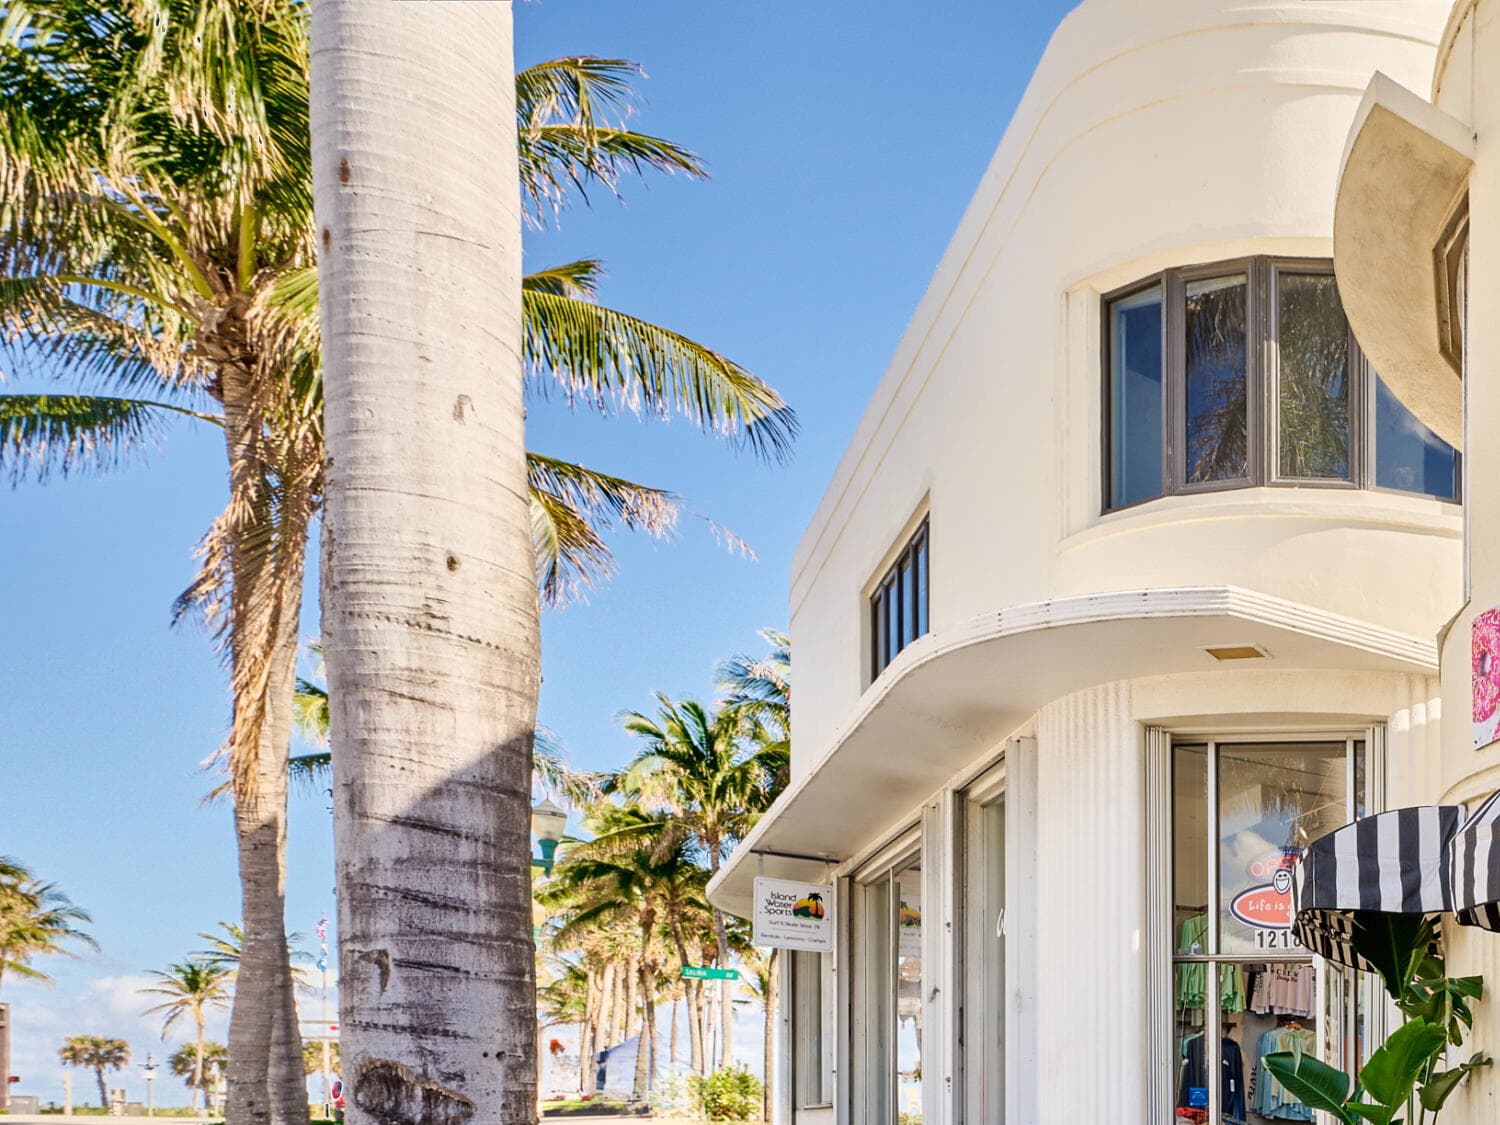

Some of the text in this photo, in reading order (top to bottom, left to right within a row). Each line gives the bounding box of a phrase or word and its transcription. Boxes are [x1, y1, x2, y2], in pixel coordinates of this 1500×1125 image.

[771, 891, 796, 901] Island
[765, 898, 792, 909] Water
[1248, 899, 1271, 911] Life
[1274, 901, 1285, 911] is
[764, 906, 792, 916] Sports
